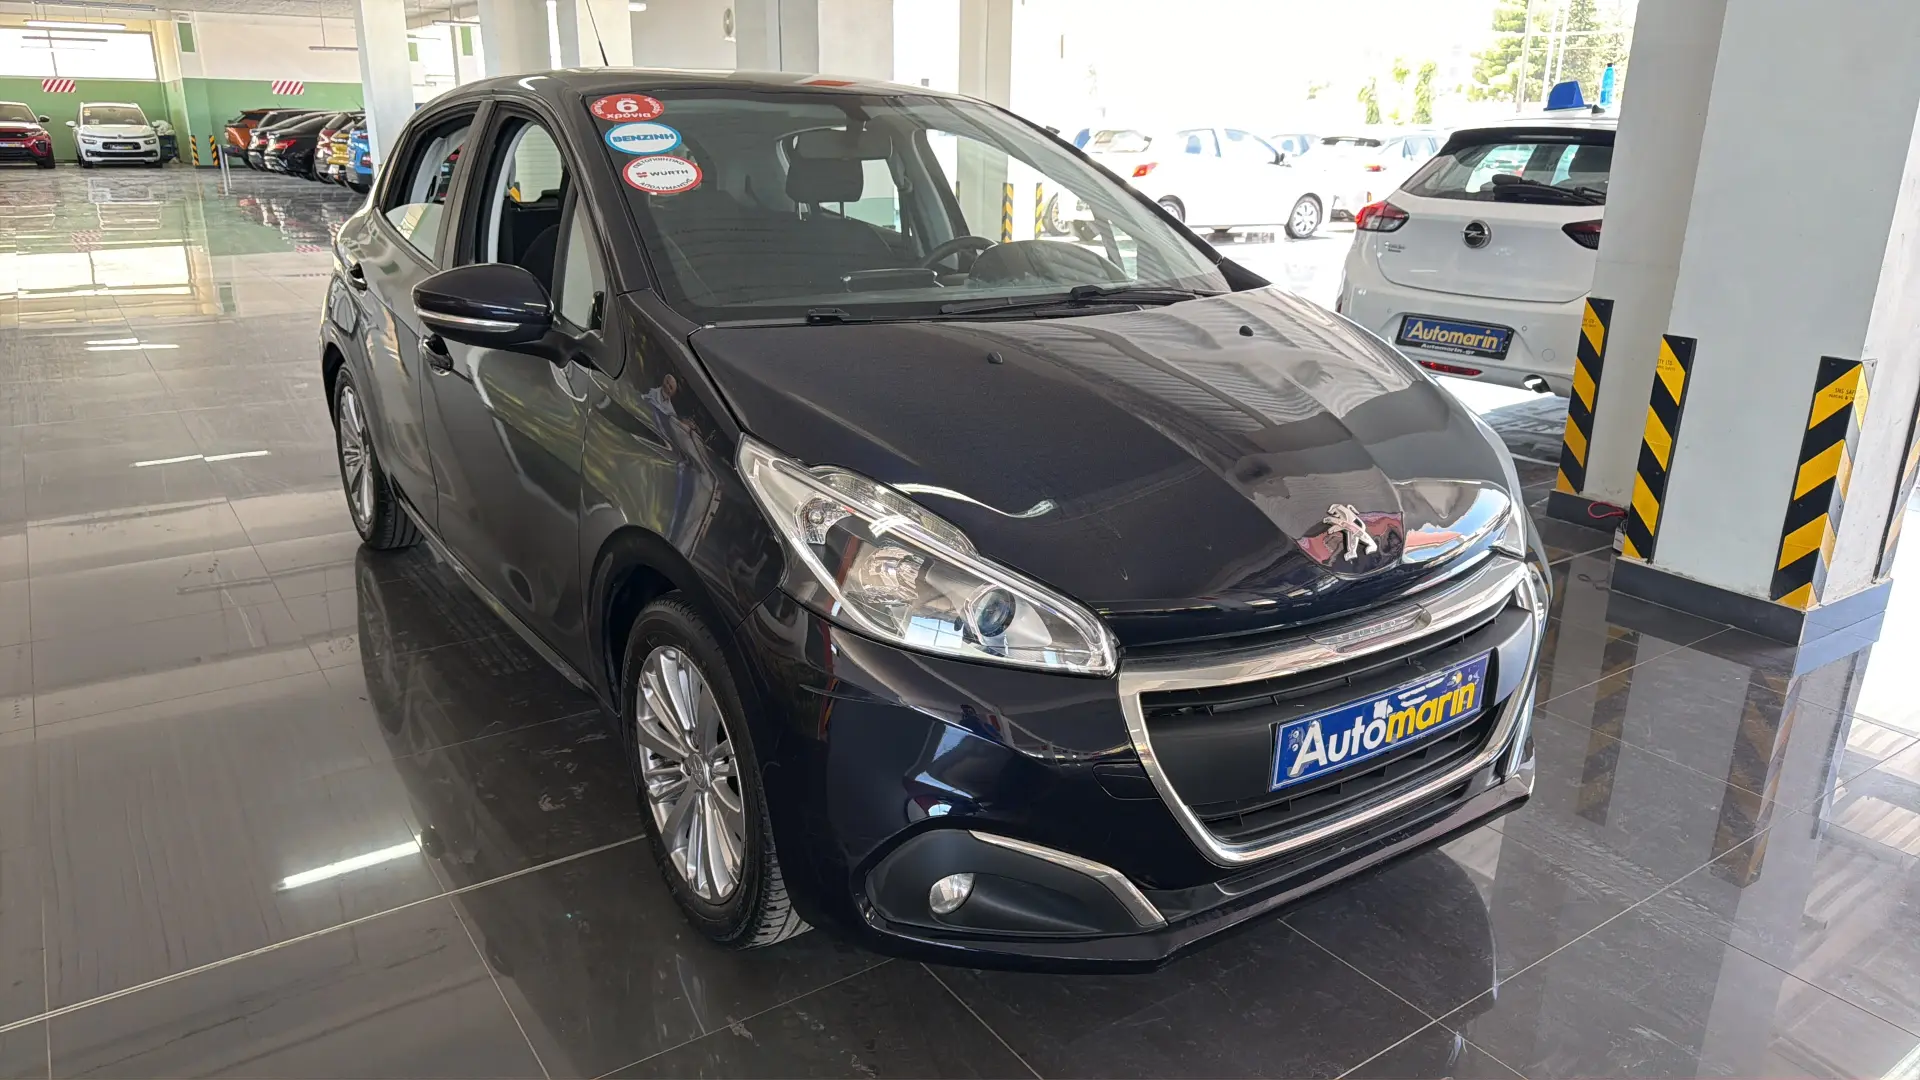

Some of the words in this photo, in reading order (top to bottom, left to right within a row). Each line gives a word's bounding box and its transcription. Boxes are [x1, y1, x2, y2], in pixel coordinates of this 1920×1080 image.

[616, 100, 639, 113] 6
[606, 112, 652, 120] χρόνια
[1407, 320, 1499, 350] Automarin
[1420, 343, 1476, 355] Automarin.gr
[1290, 670, 1477, 777] Automarin
